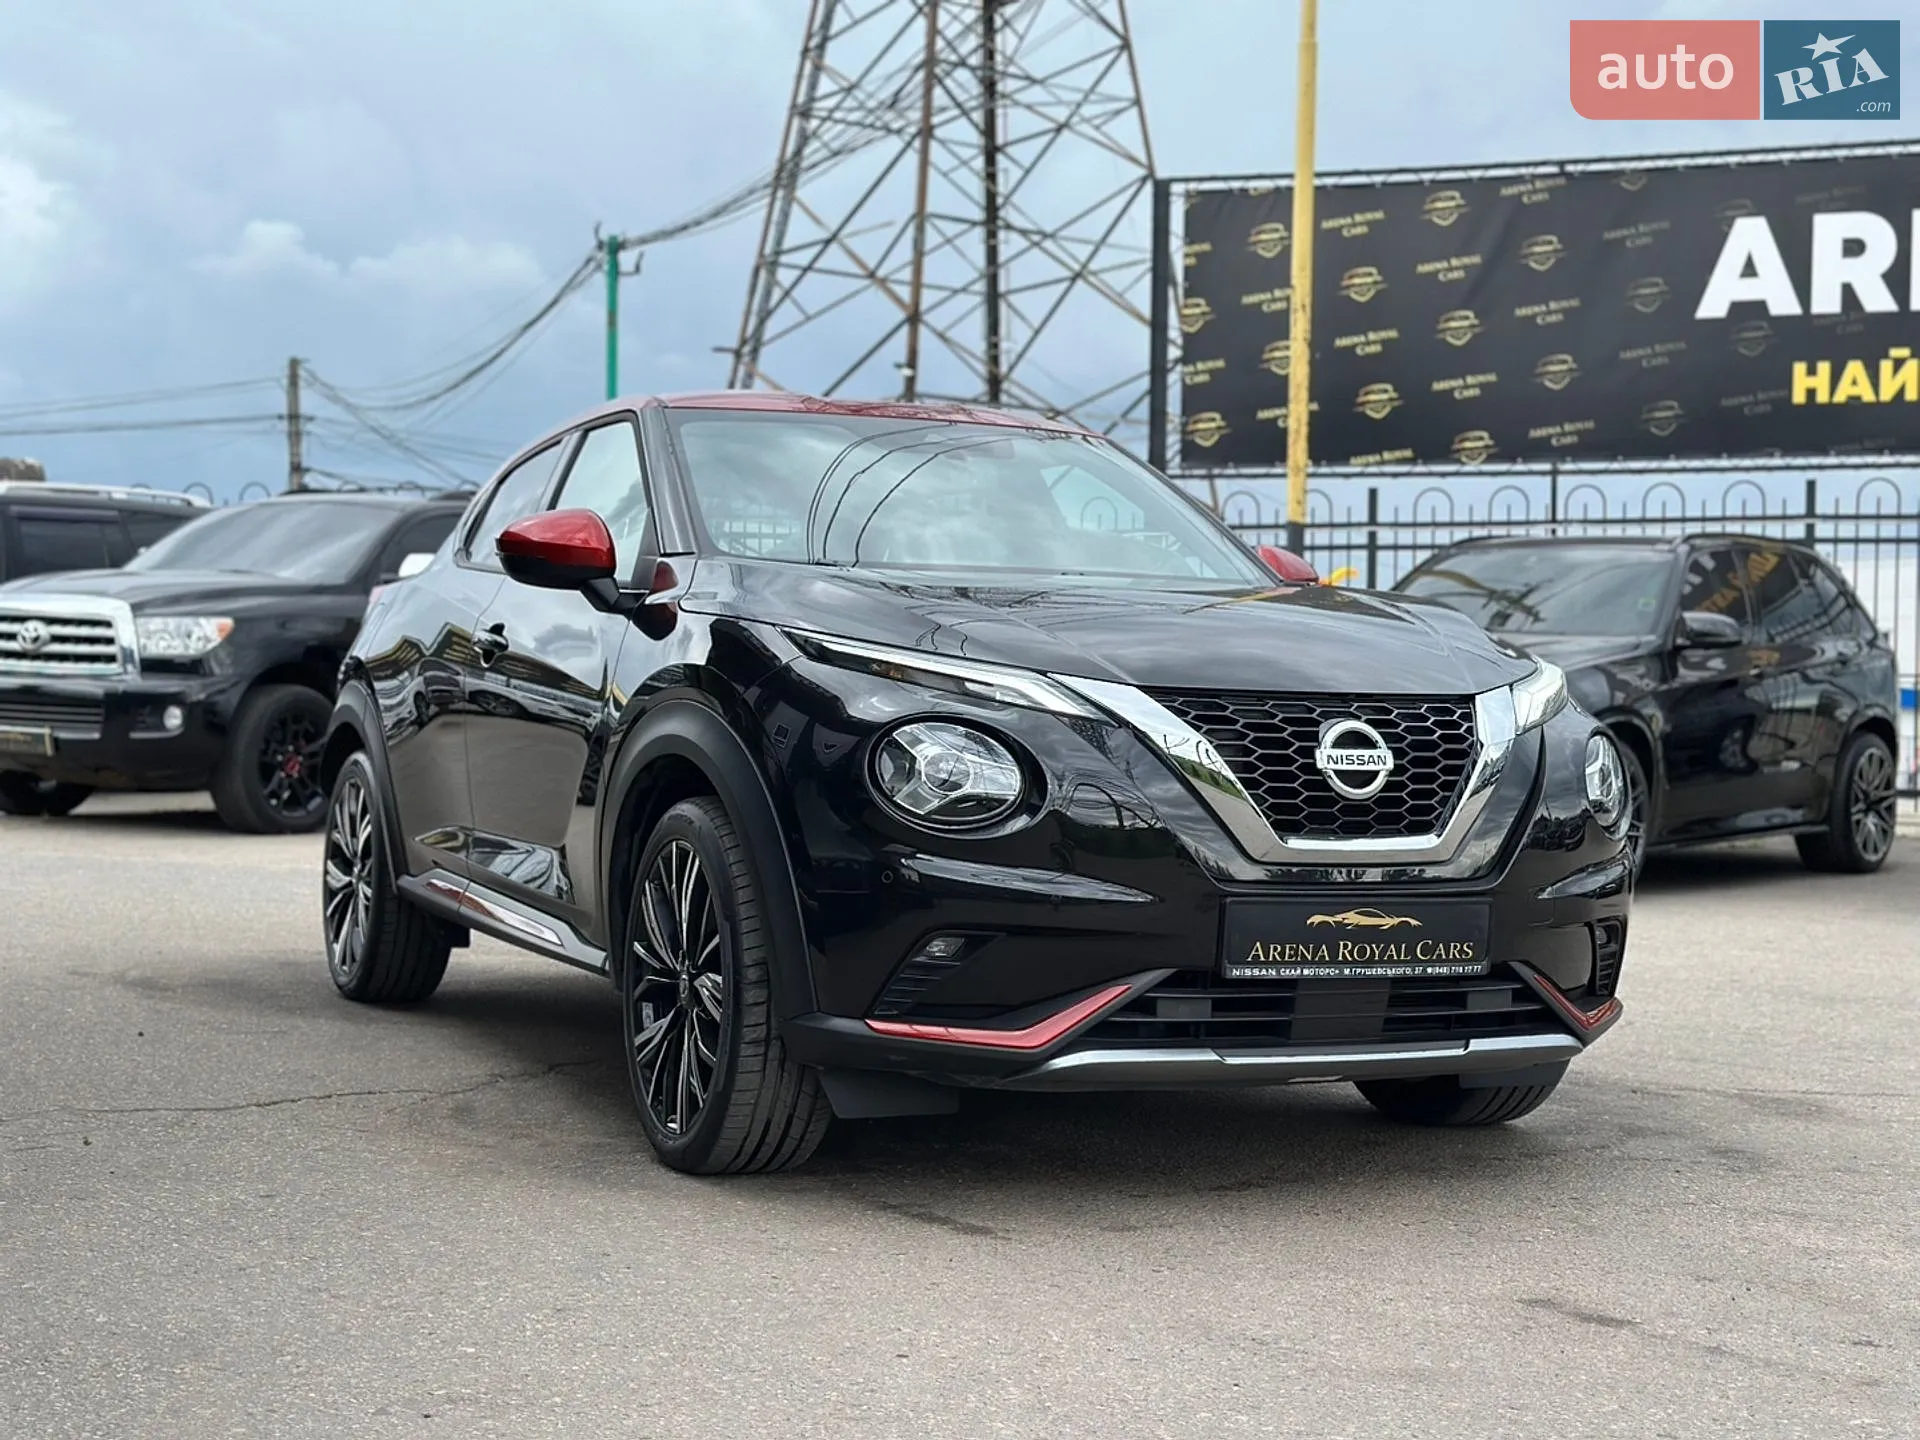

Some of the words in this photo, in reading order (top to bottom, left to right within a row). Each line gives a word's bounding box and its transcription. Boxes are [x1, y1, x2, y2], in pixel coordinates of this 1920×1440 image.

[1326, 754, 1387, 766] NISSAN
[1246, 941, 1330, 962] ARENA
[1337, 940, 1412, 961] ROYAL
[1416, 939, 1474, 960] CARS
[1232, 968, 1276, 976] NISSAN
